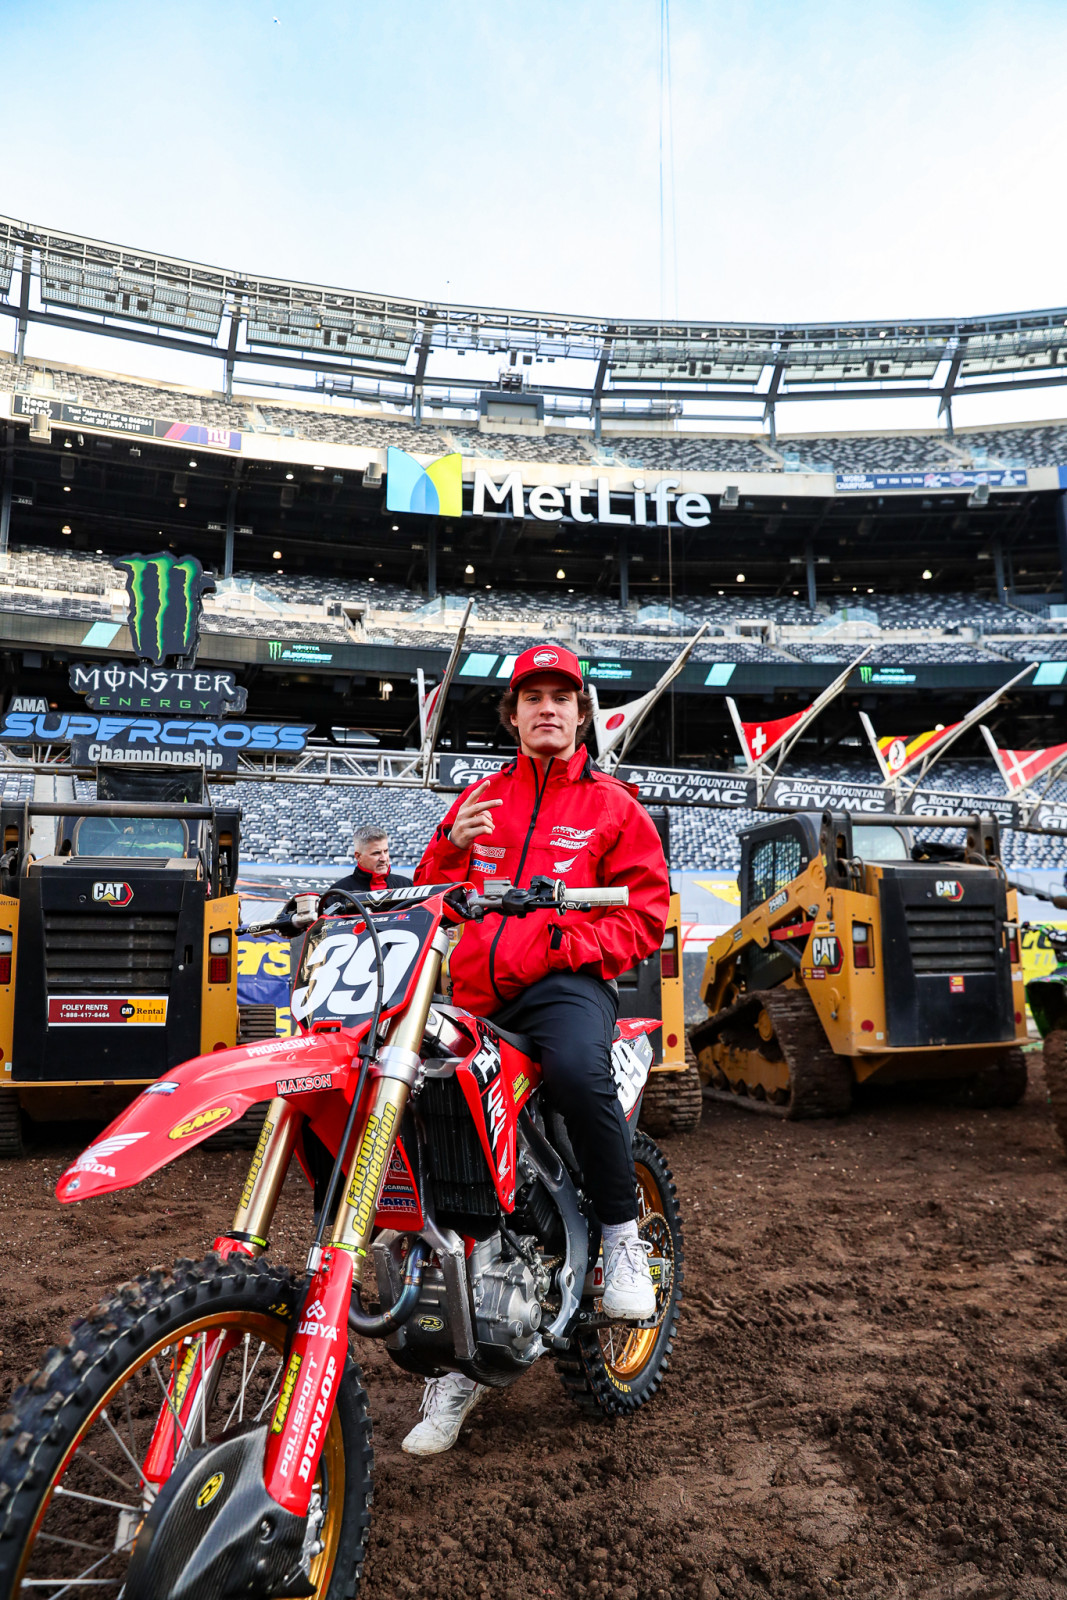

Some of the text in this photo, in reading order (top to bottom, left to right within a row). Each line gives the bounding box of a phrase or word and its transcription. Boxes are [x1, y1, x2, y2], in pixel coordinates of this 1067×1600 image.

[21, 405, 53, 417] Help?
[22, 397, 50, 408] Need
[67, 407, 81, 415] Text
[472, 469, 712, 527] MetLife
[74, 665, 236, 695] MONSTER
[12, 699, 47, 712] AMA
[99, 696, 211, 711] ENERGY
[0, 712, 311, 751] SUPERCROSS
[88, 743, 224, 770] Championship
[93, 882, 124, 901] CAT
[935, 881, 957, 896] CAT
[560, 901, 581, 910] ASV
[812, 938, 837, 966] CAT
[291, 929, 420, 1022] 39
[121, 1007, 164, 1015] CAT Rental
[247, 1036, 318, 1057] PROGRESSIVE
[276, 1074, 332, 1095] MAKSON
[170, 1107, 231, 1139] FMF
[270, 1351, 304, 1435] TAMER
[298, 1356, 338, 1484] DUNLOP
